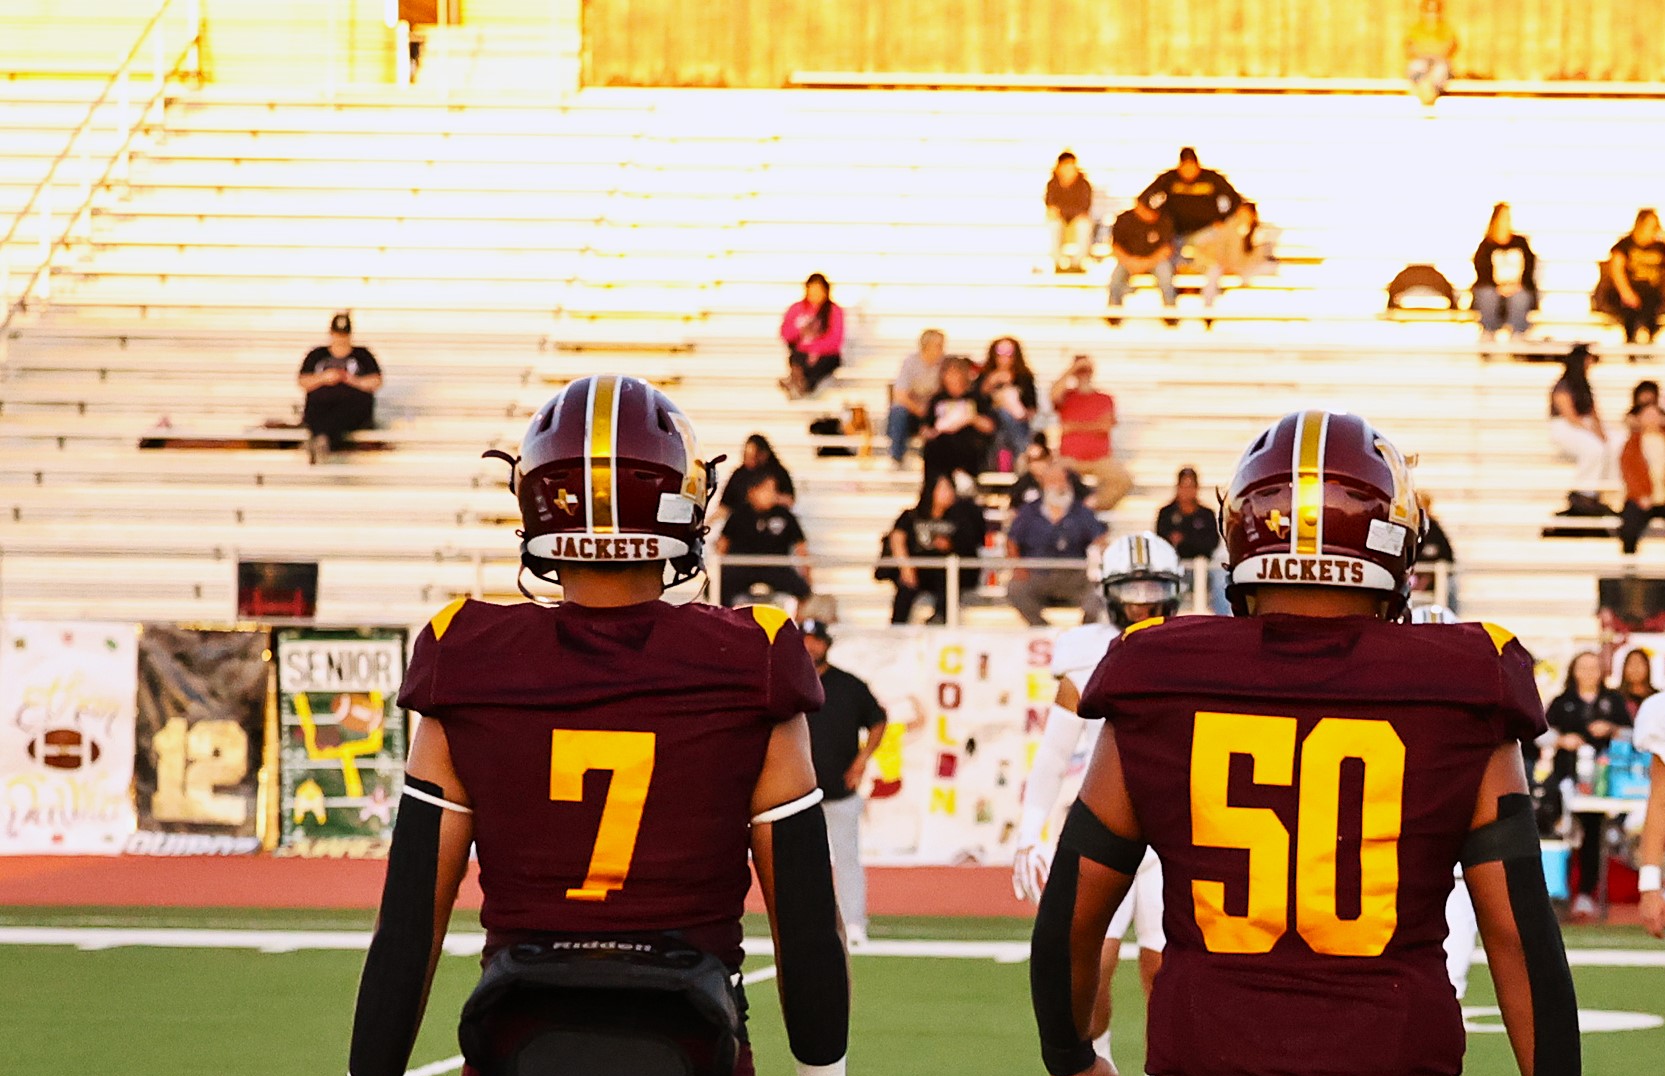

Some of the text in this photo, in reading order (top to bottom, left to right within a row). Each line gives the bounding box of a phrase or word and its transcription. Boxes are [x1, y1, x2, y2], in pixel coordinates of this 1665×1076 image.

[551, 536, 659, 559] JACKETS
[1256, 558, 1364, 583] JACKETS
[286, 650, 392, 687] SENIOR
[151, 716, 249, 827] 12
[549, 728, 656, 901] 7
[1190, 711, 1406, 957] 50
